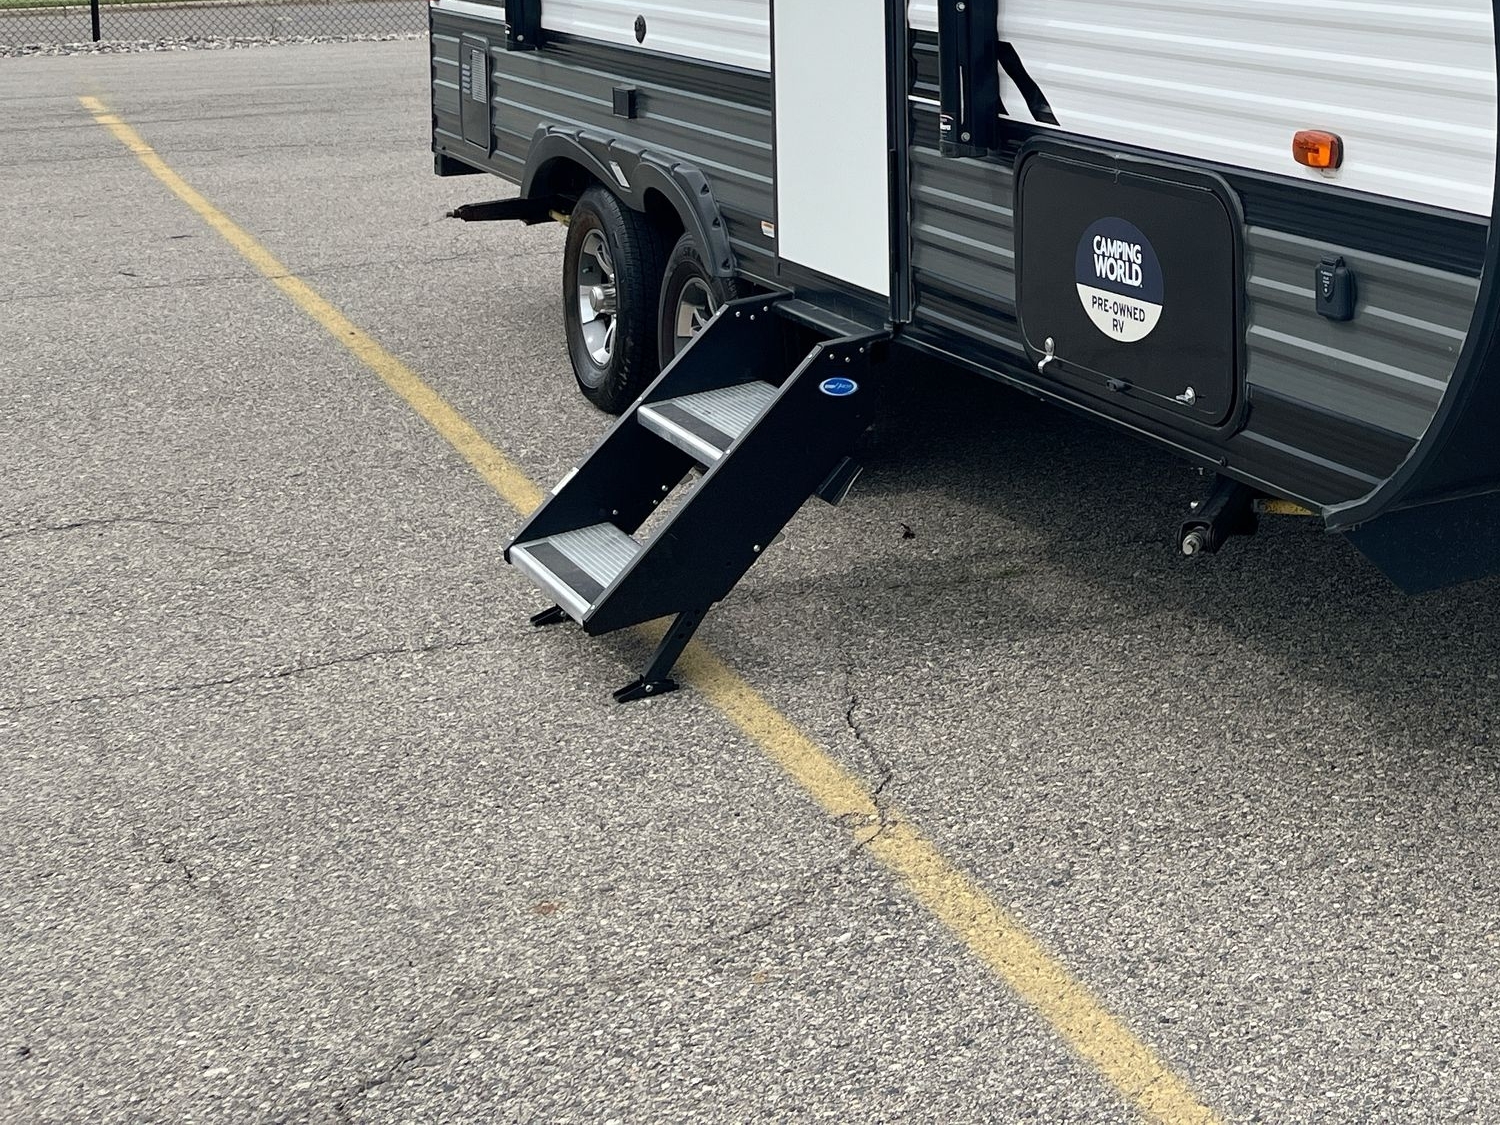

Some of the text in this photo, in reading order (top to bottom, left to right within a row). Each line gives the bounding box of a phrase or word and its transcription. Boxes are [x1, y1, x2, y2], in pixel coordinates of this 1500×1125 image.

[1093, 235, 1142, 264] CAMPING
[1091, 295, 1146, 322] PRE-OWNED
[1112, 318, 1125, 333] RV
